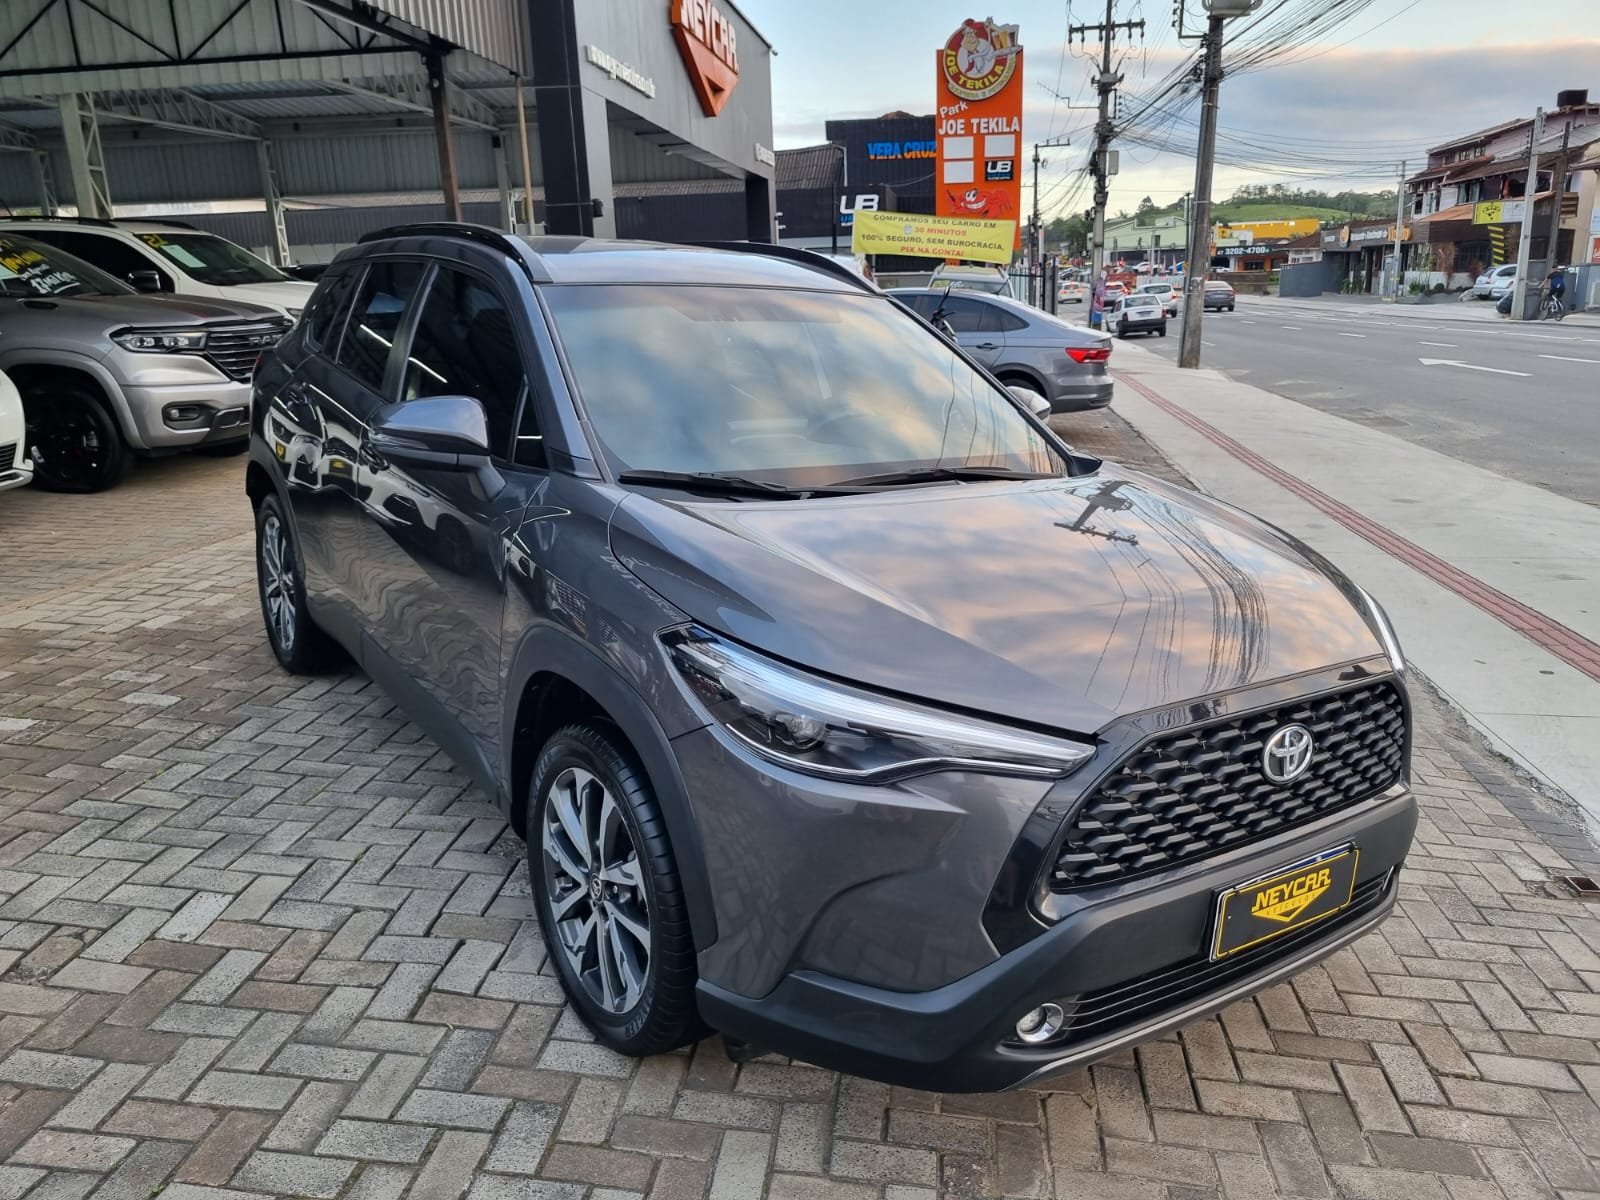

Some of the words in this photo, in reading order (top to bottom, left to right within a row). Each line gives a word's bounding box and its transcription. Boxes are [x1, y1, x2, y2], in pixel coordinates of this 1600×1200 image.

[680, 0, 740, 75] NEYCAR
[946, 49, 959, 77] JOE
[958, 65, 1004, 90] TEKILA
[940, 101, 968, 118] Park
[938, 119, 965, 135] JOE
[970, 117, 1020, 134] TEKILA
[867, 142, 902, 160] VERA
[903, 140, 937, 159] CRUZ
[987, 160, 1012, 173] UB
[840, 194, 879, 214] UB
[873, 214, 929, 224] COMPRAMOS
[951, 219, 981, 227] CARRO
[861, 233, 883, 241] 100%
[927, 227, 967, 237] MINUTOS
[1225, 246, 1265, 255] 3202-4700
[1251, 867, 1332, 912] NEYCAR
